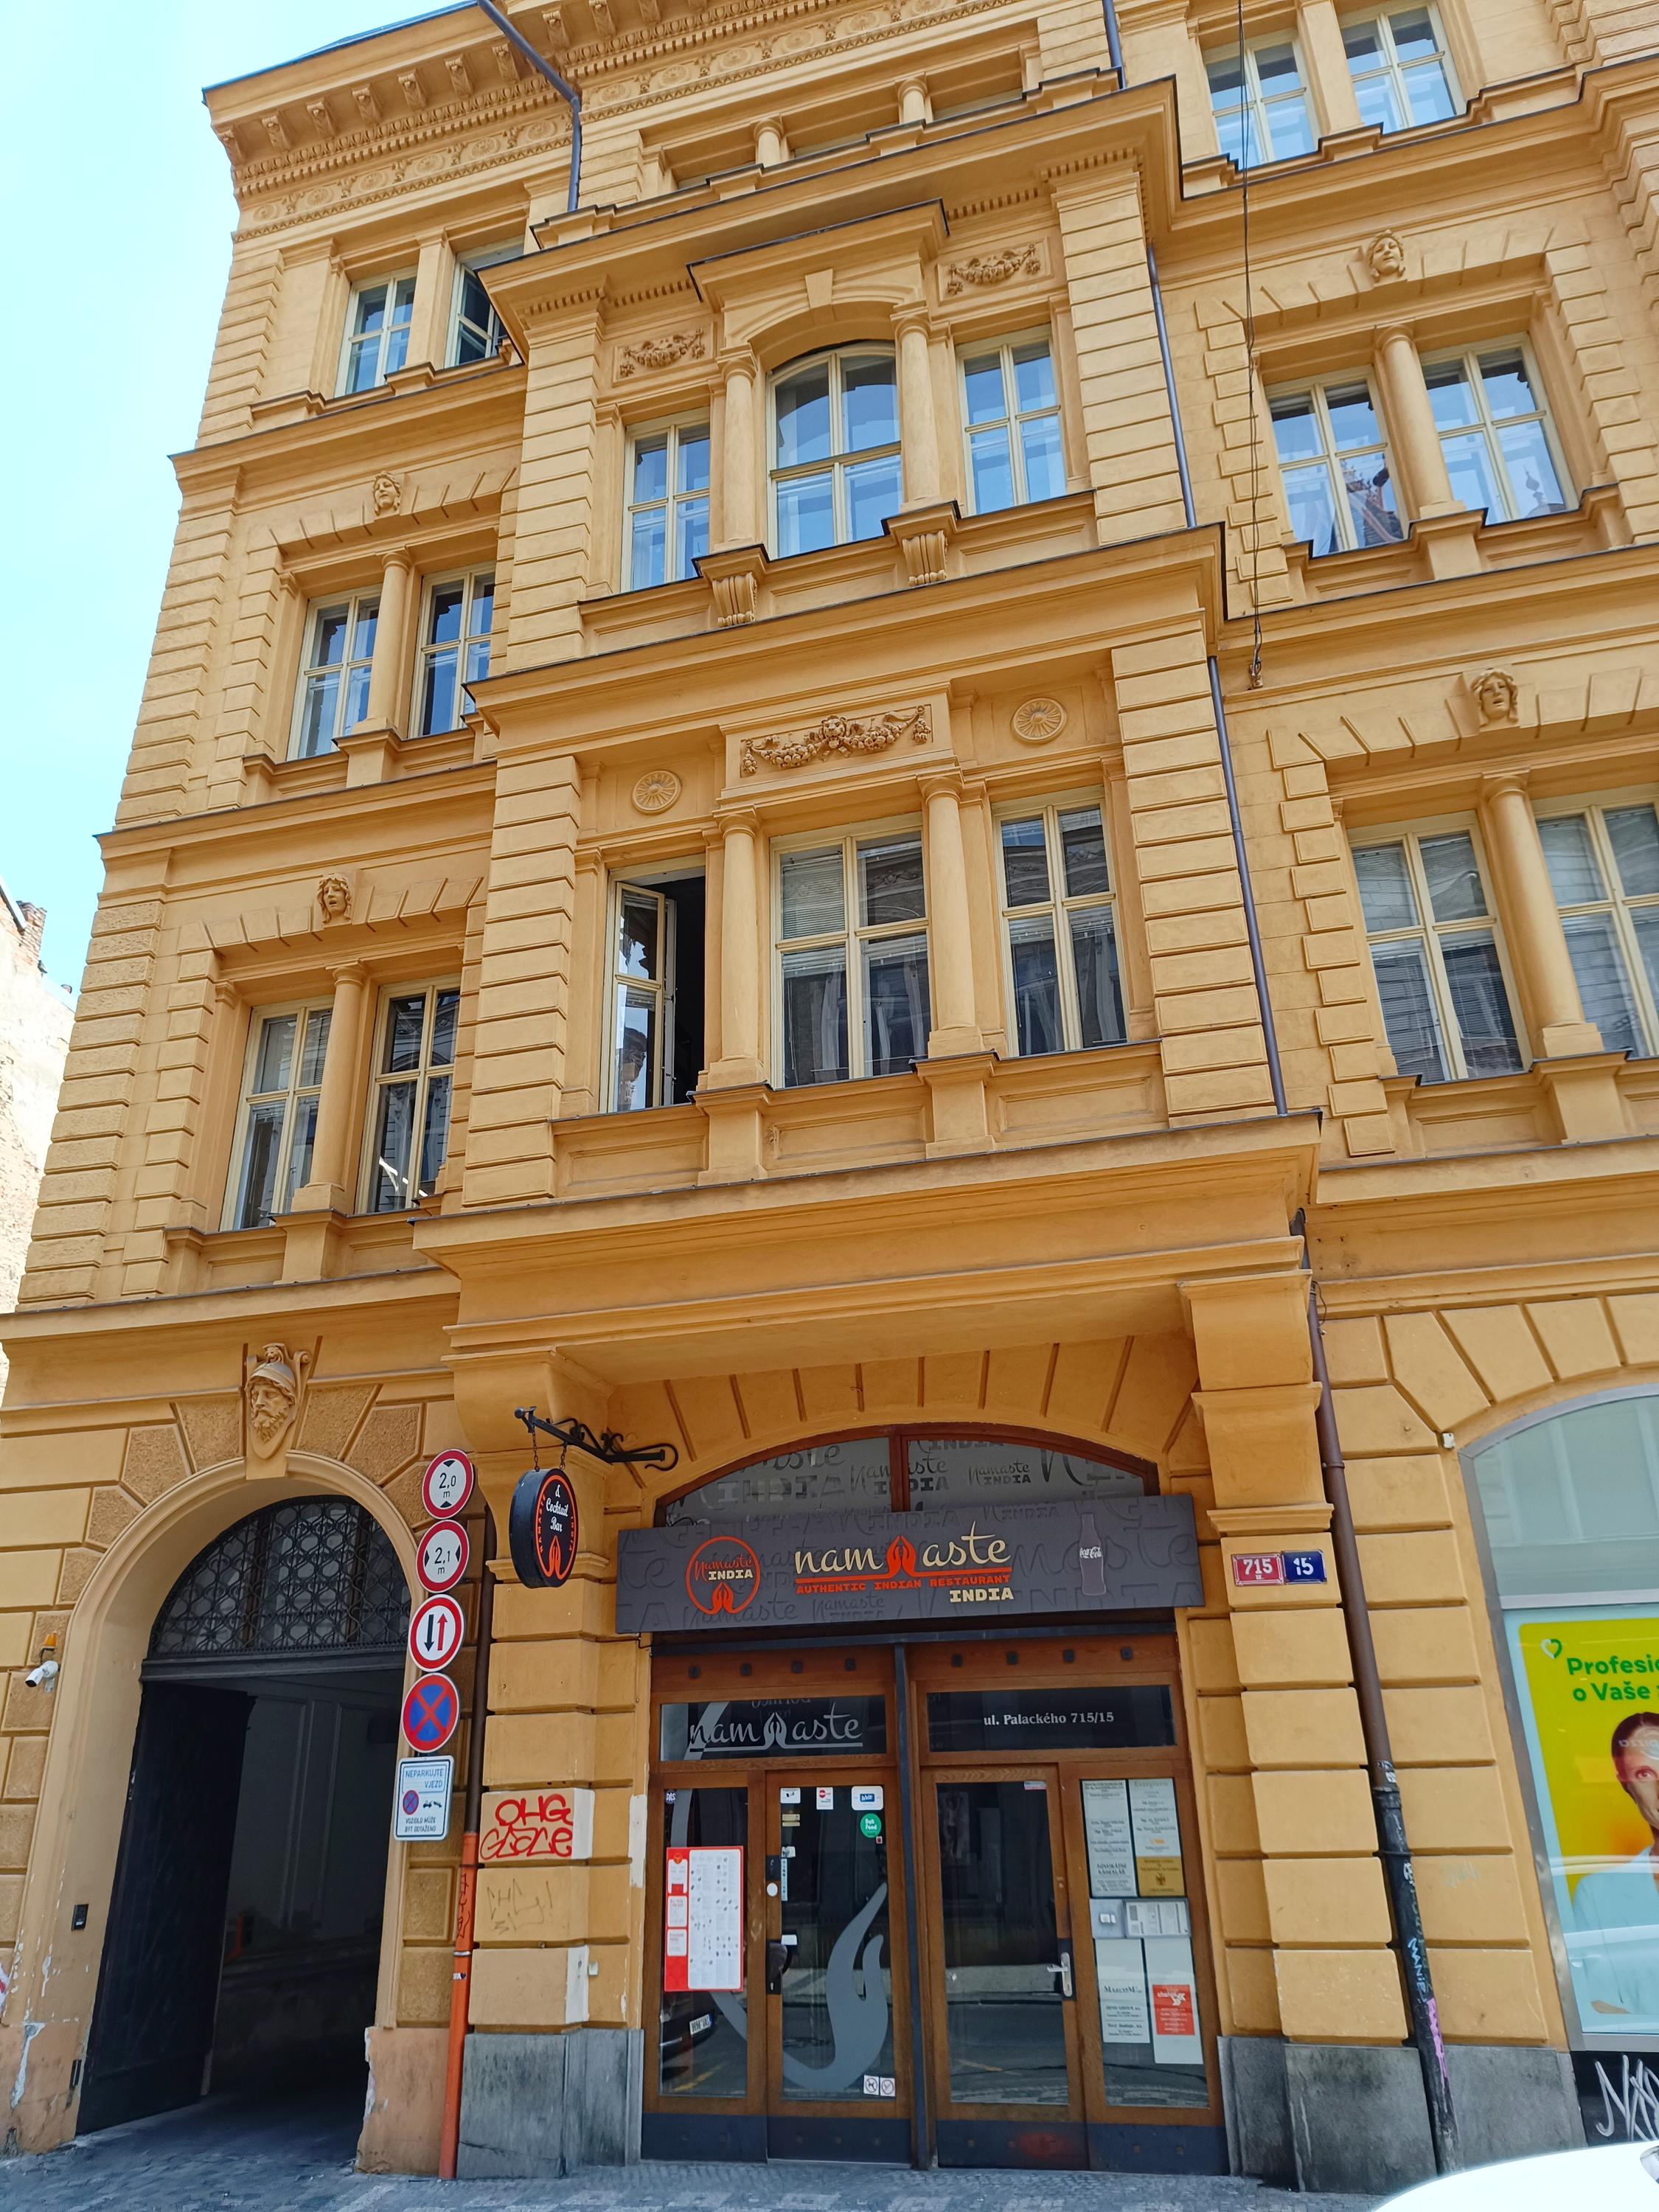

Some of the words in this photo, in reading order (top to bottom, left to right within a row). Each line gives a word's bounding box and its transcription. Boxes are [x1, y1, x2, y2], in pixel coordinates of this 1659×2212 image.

[439, 1472, 456, 1489] 2,0
[442, 1490, 451, 1498] m
[546, 1499, 568, 1517] Cocktail
[550, 1517, 563, 1532] Bar
[434, 1547, 451, 1565] 2,1
[437, 1566, 445, 1574] m
[708, 1568, 754, 1580] INDIA
[1243, 1558, 1273, 1575] 715
[1293, 1557, 1314, 1576] 15
[796, 1583, 866, 1594] AUTHENTIC
[874, 1579, 921, 1590] INDIAN
[929, 1574, 1010, 1587] RESTAURANT
[950, 1587, 1015, 1603] INDIA
[1573, 1687, 1587, 1702] o
[1590, 1681, 1651, 1701] Vaše
[984, 1714, 999, 1725] ul.
[1004, 1713, 1066, 1725] Palackého
[1071, 1712, 1114, 1724] 715/15
[406, 1768, 444, 1778] NEPARKUJTE
[424, 1780, 442, 1789] VJEZD
